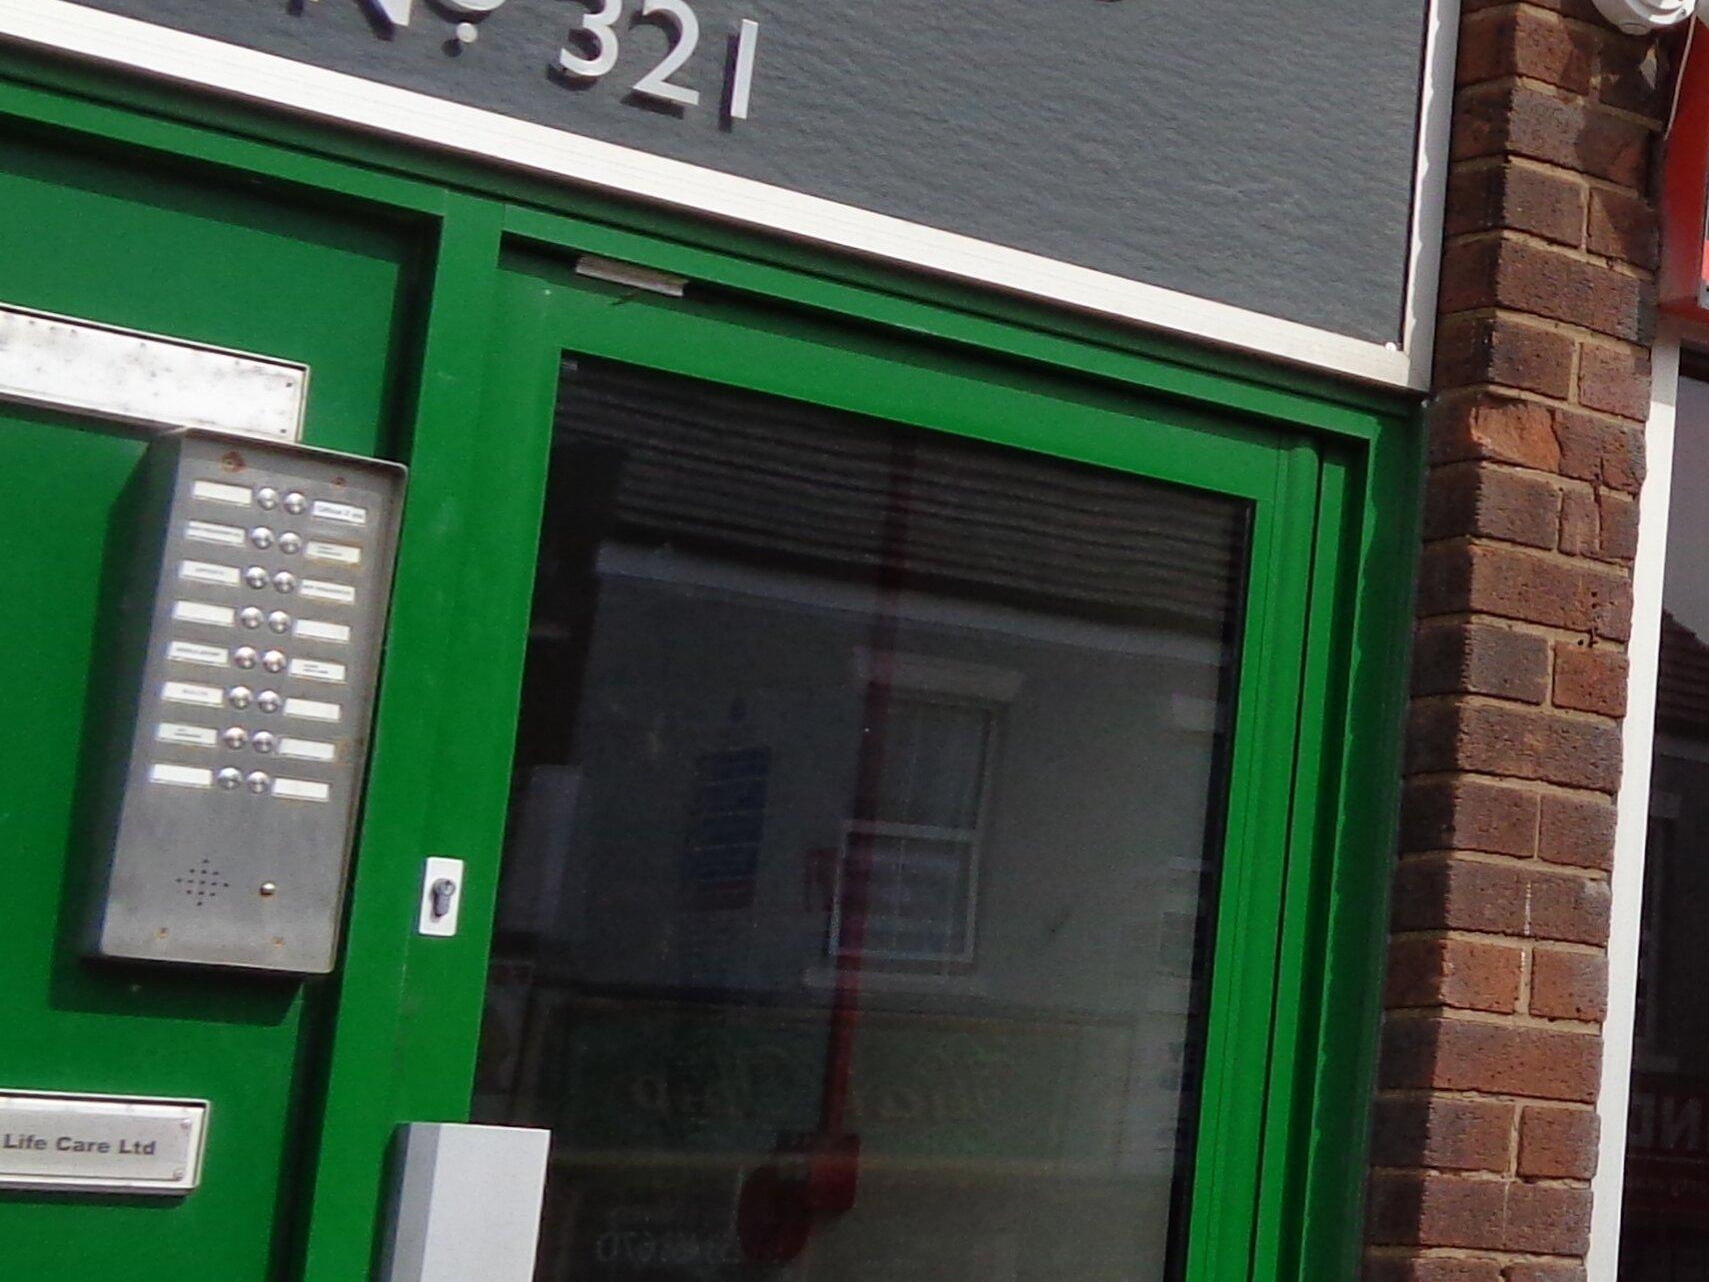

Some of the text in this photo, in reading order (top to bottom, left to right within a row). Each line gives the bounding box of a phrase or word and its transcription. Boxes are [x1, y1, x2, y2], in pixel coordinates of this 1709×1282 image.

[3, 1133, 157, 1156] Life Care Ltd
